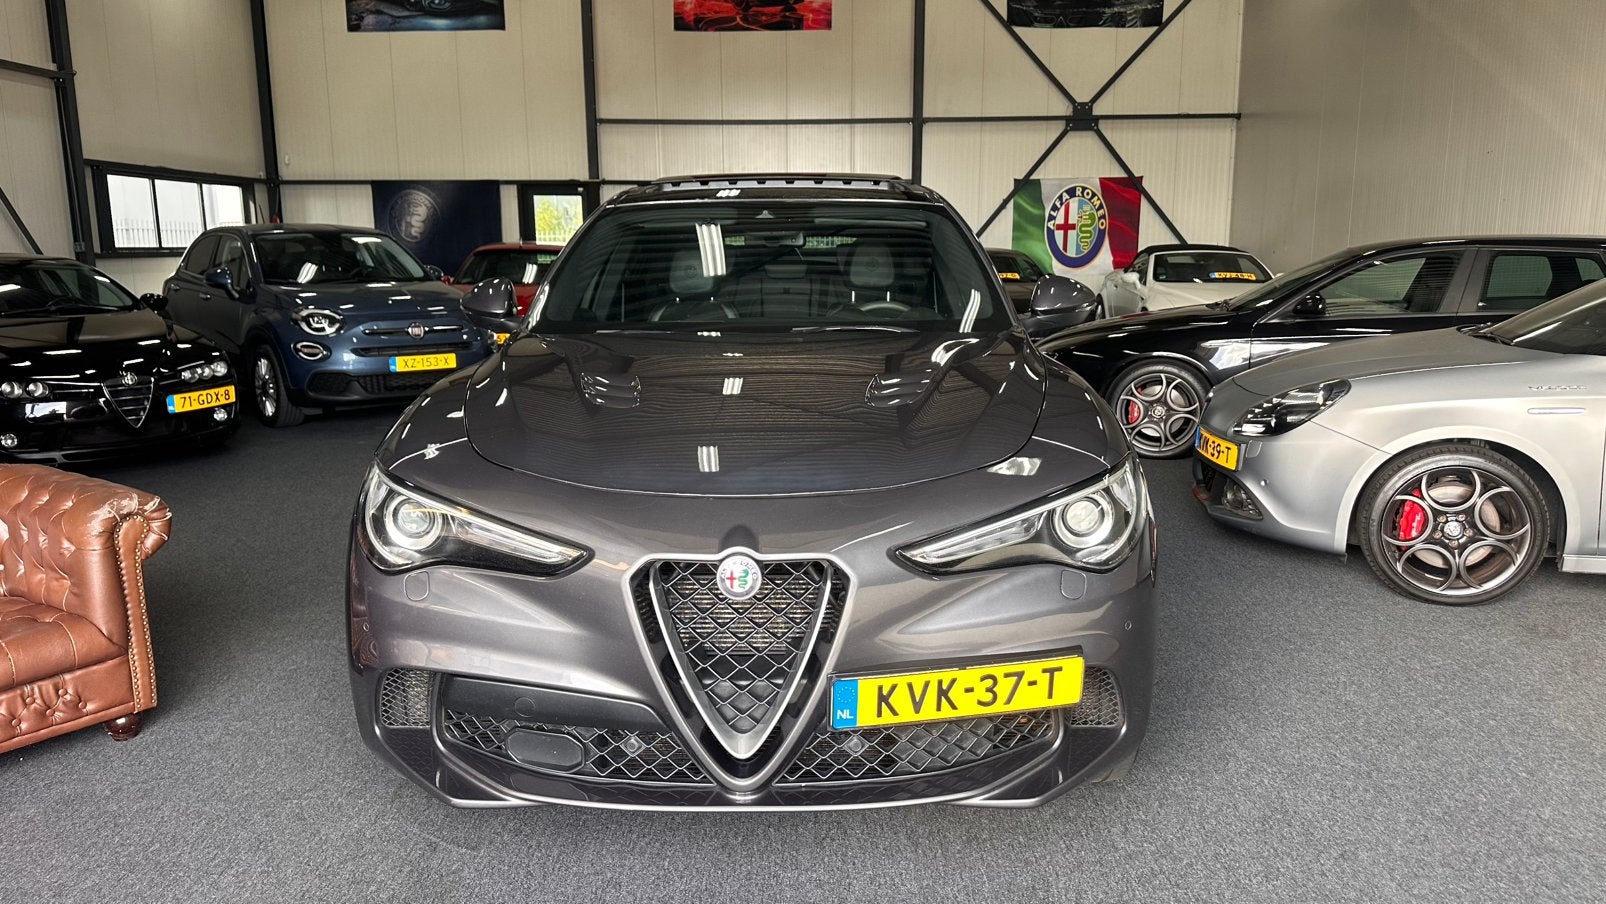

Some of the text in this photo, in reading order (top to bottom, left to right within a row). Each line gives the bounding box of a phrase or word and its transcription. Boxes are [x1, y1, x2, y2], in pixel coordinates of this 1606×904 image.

[1047, 187, 1106, 230] ALFA ROMEO
[403, 356, 449, 368] XZ-153-X
[180, 389, 230, 408] 71-GDX-8
[876, 666, 1063, 718] KVK-37-T
[836, 709, 854, 720] NL
